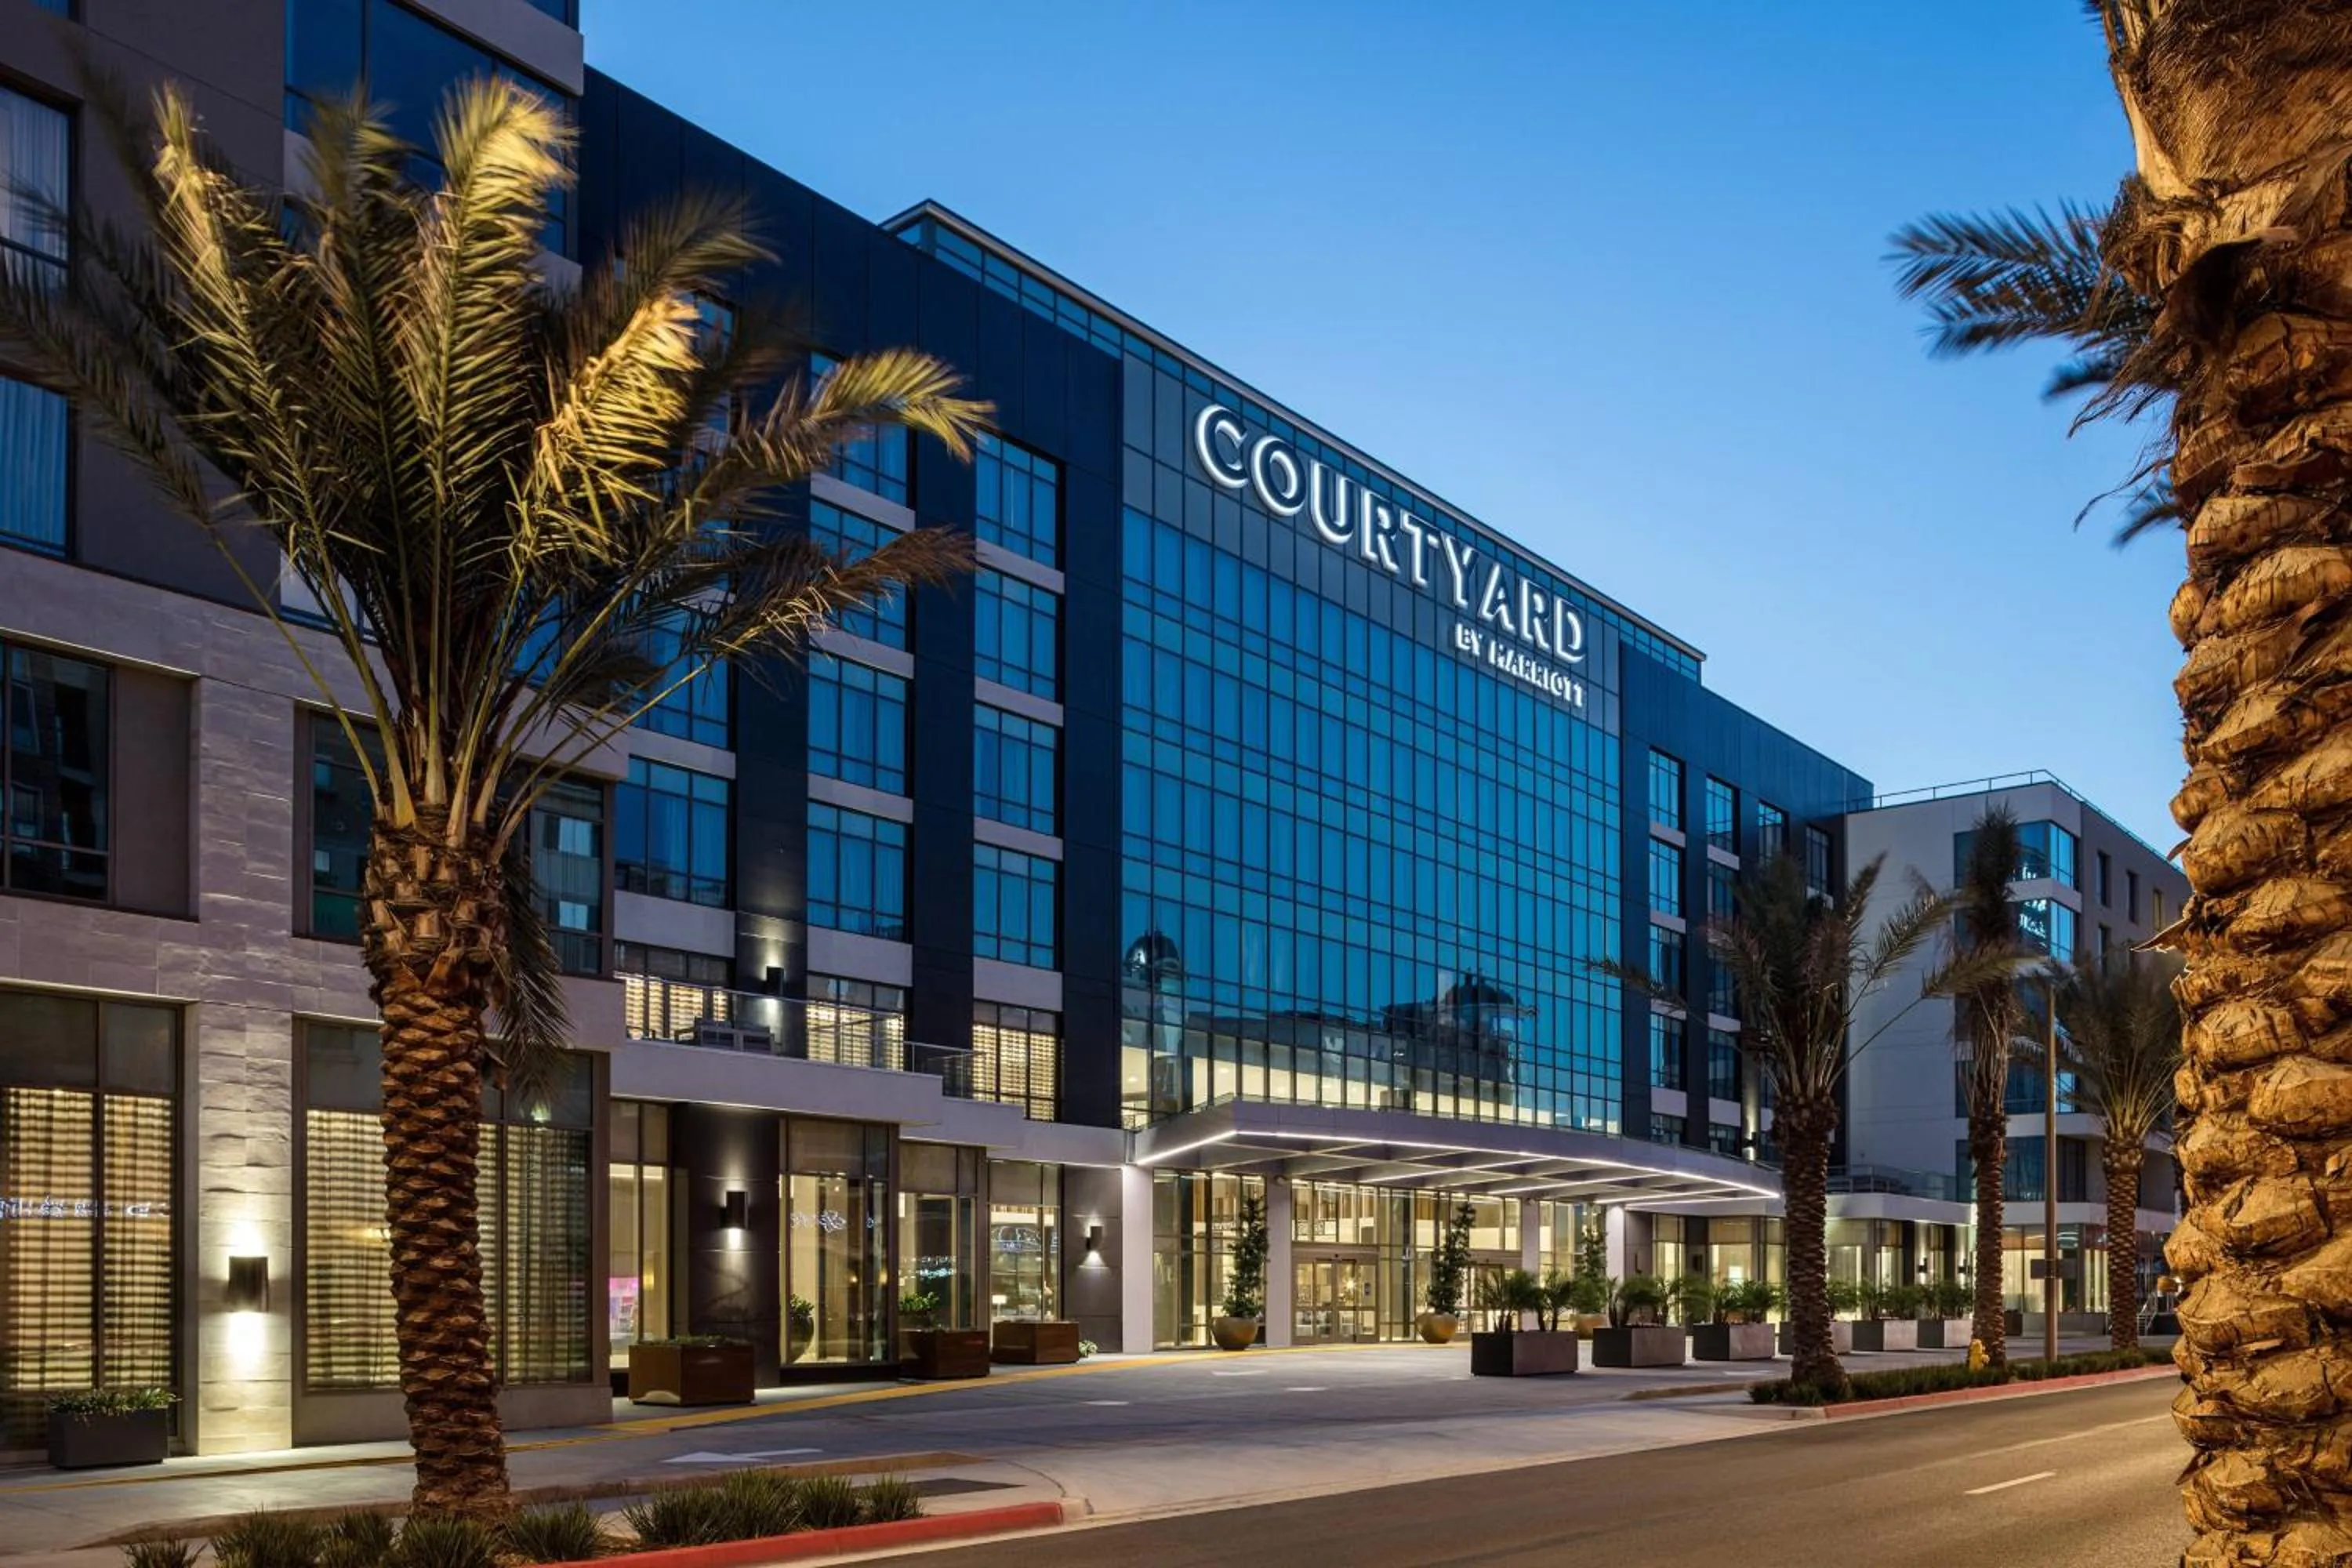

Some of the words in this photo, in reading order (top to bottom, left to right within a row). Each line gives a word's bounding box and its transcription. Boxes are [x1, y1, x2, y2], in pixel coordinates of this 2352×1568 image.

[1194, 403, 1587, 665] COURTYARD
[1454, 622, 1483, 657] BY
[1487, 639, 1584, 708] MARRIOTT
